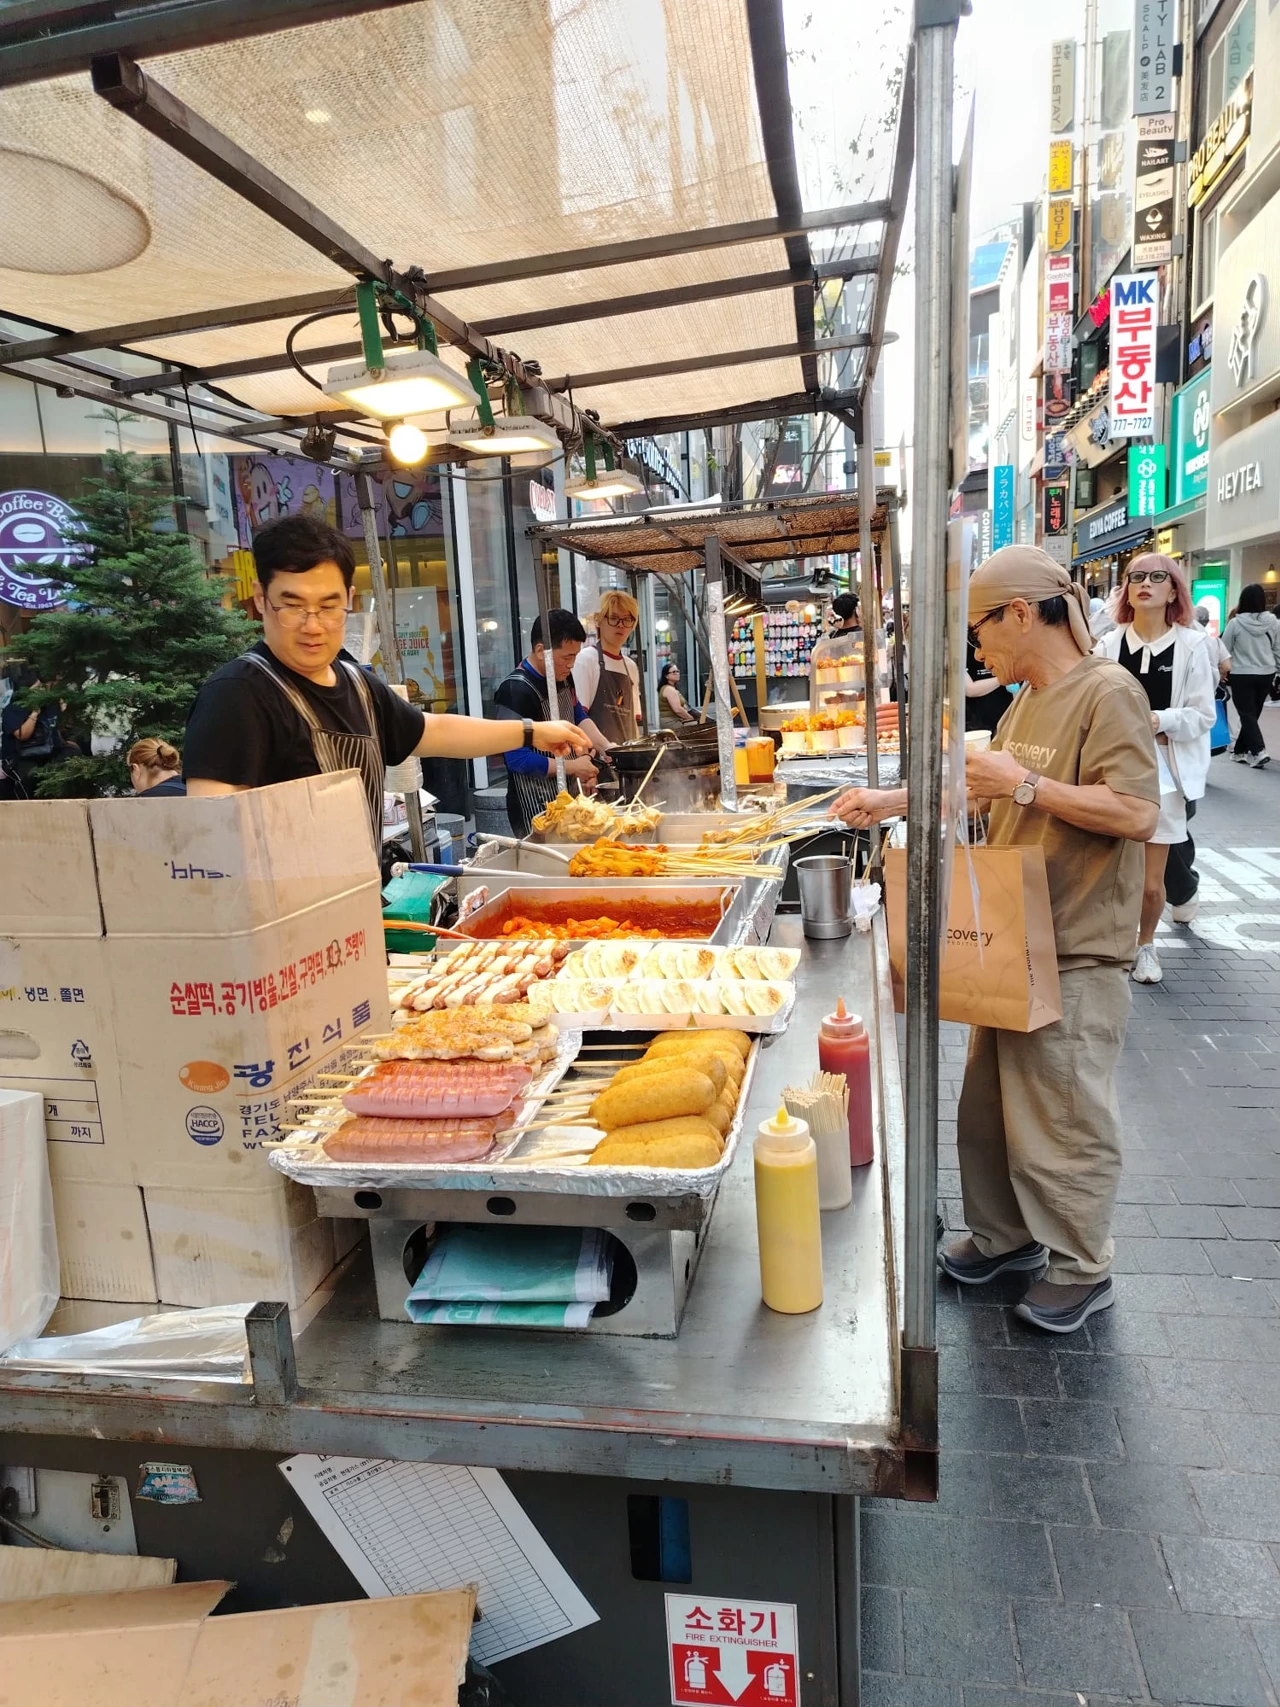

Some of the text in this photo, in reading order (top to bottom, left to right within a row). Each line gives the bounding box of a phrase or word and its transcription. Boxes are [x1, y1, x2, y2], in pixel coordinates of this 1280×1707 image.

[1142, 4, 1150, 51] SCALP
[1155, 34, 1167, 75] LAB
[1052, 45, 1062, 124] PHILSTAY
[1155, 85, 1165, 100] 2
[1140, 125, 1173, 136] Beauty
[1148, 118, 1165, 127] Pro
[1050, 140, 1070, 148] MIZO
[1141, 157, 1169, 167] NAILART
[1188, 143, 1205, 188] PRO
[1139, 189, 1170, 199] EYELASHES
[1050, 200, 1069, 209] MIZO
[1053, 208, 1065, 246] HOTEL
[1139, 232, 1167, 242] WAXING
[1114, 278, 1156, 307] MK
[1047, 317, 1060, 368] 부동산
[1114, 307, 1153, 415] 부동산
[1025, 395, 1033, 432] BTTER
[1113, 417, 1152, 431] 777-7727
[1217, 460, 1264, 502] HEYTEA
[46, 500, 77, 532] Bea
[1089, 506, 1127, 540] EDIYA COFFEE
[982, 511, 990, 561] CONVERS
[7, 582, 37, 603] Tea
[409, 638, 430, 649] JUICE
[24, 986, 49, 1002] 냉면
[60, 987, 85, 1003] 쫄면
[188, 1079, 213, 1092] Kwang
[240, 1098, 281, 1115] 경기도
[283, 1075, 315, 1102] 남양주시
[47, 1104, 58, 1117] 개
[191, 1119, 219, 1128] HACCP
[240, 1112, 280, 1126] TEL
[71, 1126, 91, 1139] 까지
[242, 1123, 282, 1138] FAX
[685, 1606, 777, 1639] 소화기
[685, 1633, 778, 1648] FIRE EXTINGUISHER
